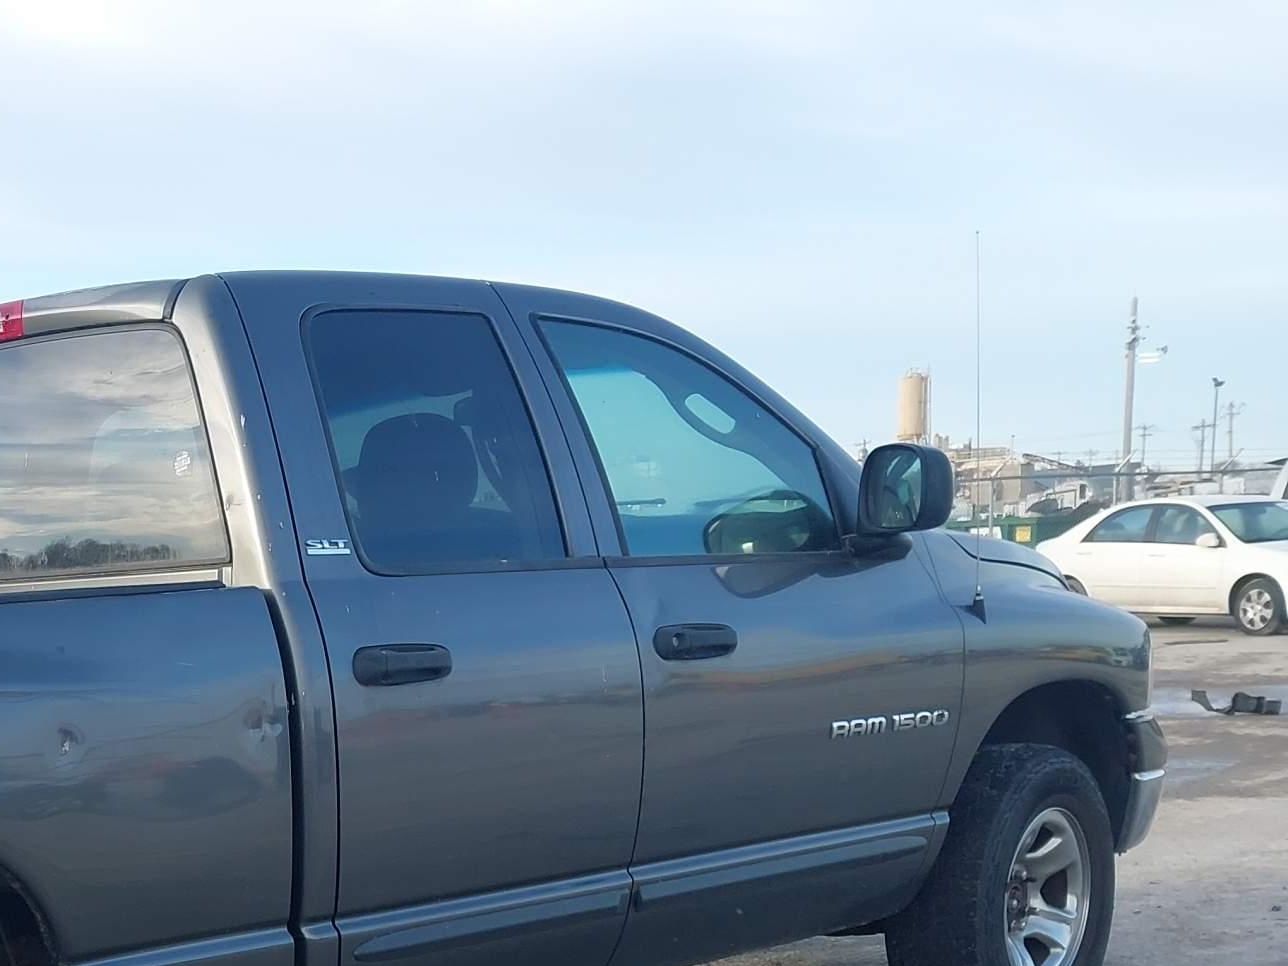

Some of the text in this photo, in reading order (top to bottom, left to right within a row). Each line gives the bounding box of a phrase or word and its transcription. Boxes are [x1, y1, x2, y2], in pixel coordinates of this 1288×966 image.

[305, 539, 349, 549] SLT
[831, 709, 950, 740] RAM 1500
